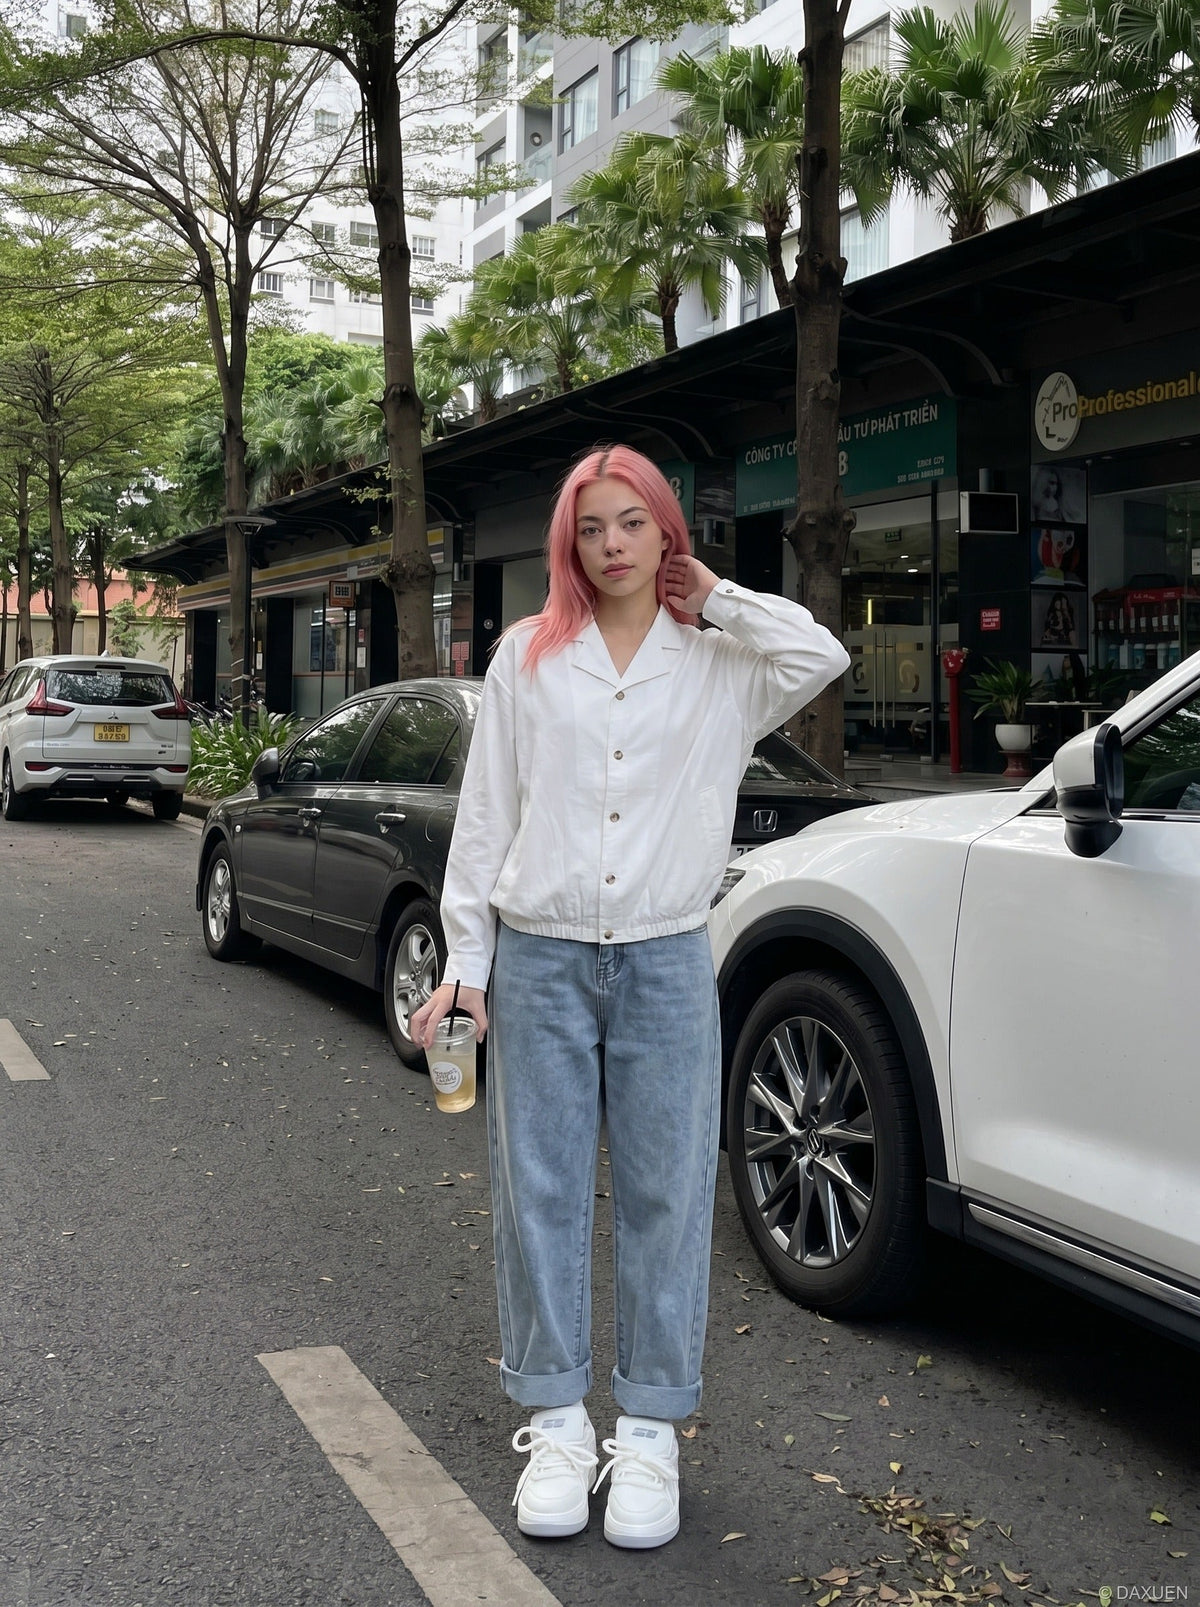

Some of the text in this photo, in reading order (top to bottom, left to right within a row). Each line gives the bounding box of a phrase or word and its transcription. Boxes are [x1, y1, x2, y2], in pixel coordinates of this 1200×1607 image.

[1053, 402, 1078, 423] Pro
[1077, 370, 1197, 418] Professional
[745, 446, 771, 465] CÔNG
[772, 442, 785, 459] TY
[853, 418, 870, 439] TƯ
[870, 411, 901, 436] PHÁT
[902, 399, 938, 427] TRIỂN
